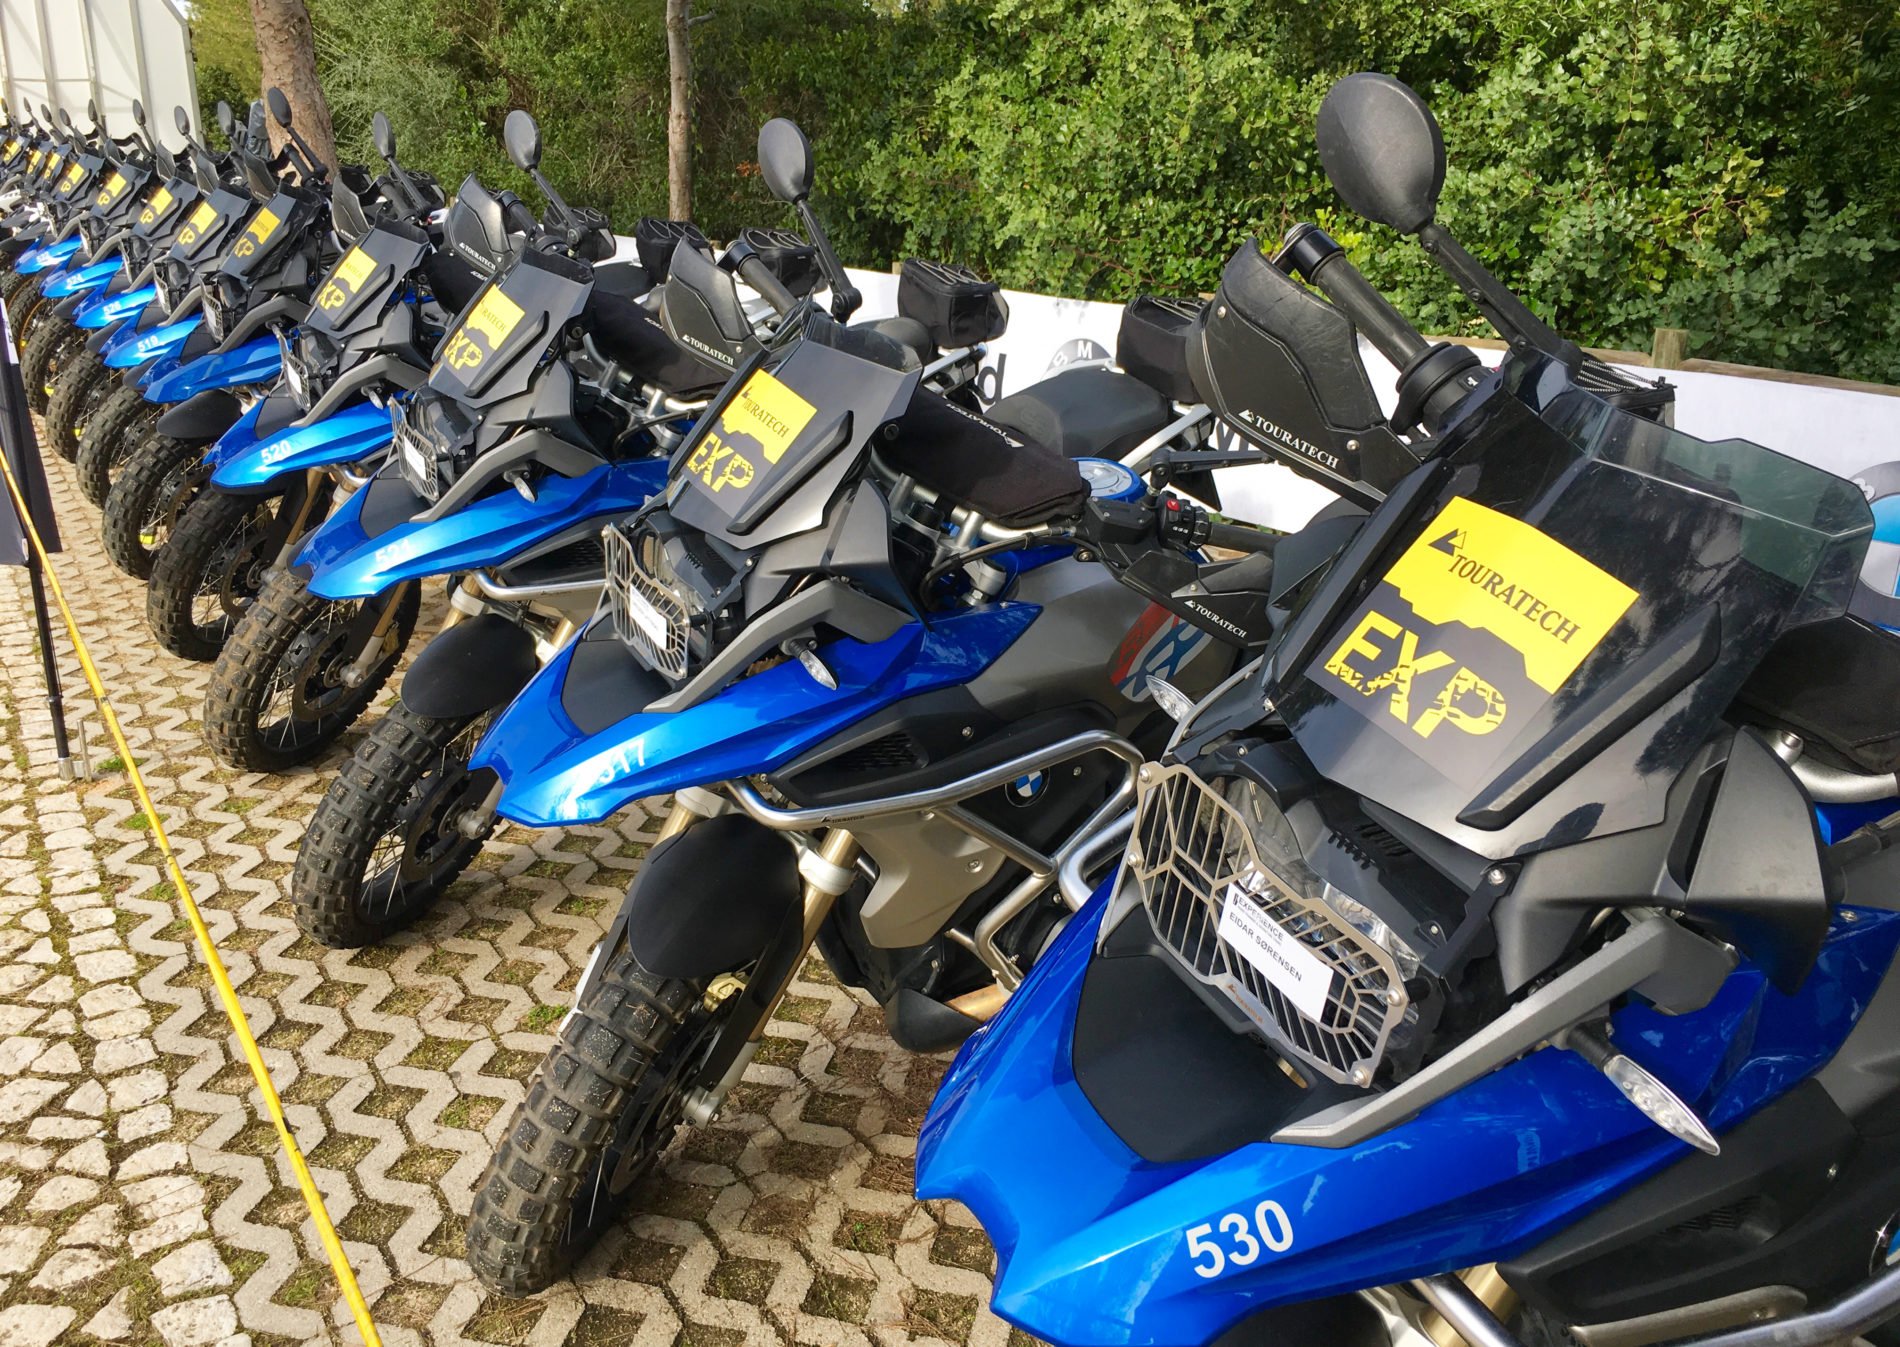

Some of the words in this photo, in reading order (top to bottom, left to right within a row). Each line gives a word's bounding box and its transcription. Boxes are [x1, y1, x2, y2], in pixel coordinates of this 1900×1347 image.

[137, 334, 159, 353] 519
[689, 337, 734, 366] TOURATECH
[260, 439, 292, 464] 520
[687, 431, 755, 493] EXP
[1255, 415, 1340, 470] TOURATECH
[1195, 603, 1248, 639] TOURATECH
[1448, 554, 1582, 645] TOURATECH
[1324, 610, 1507, 739] EXP
[1229, 911, 1255, 939] EIDAR
[1255, 935, 1303, 982] SØRENSEN
[1185, 1199, 1294, 1279] 530
